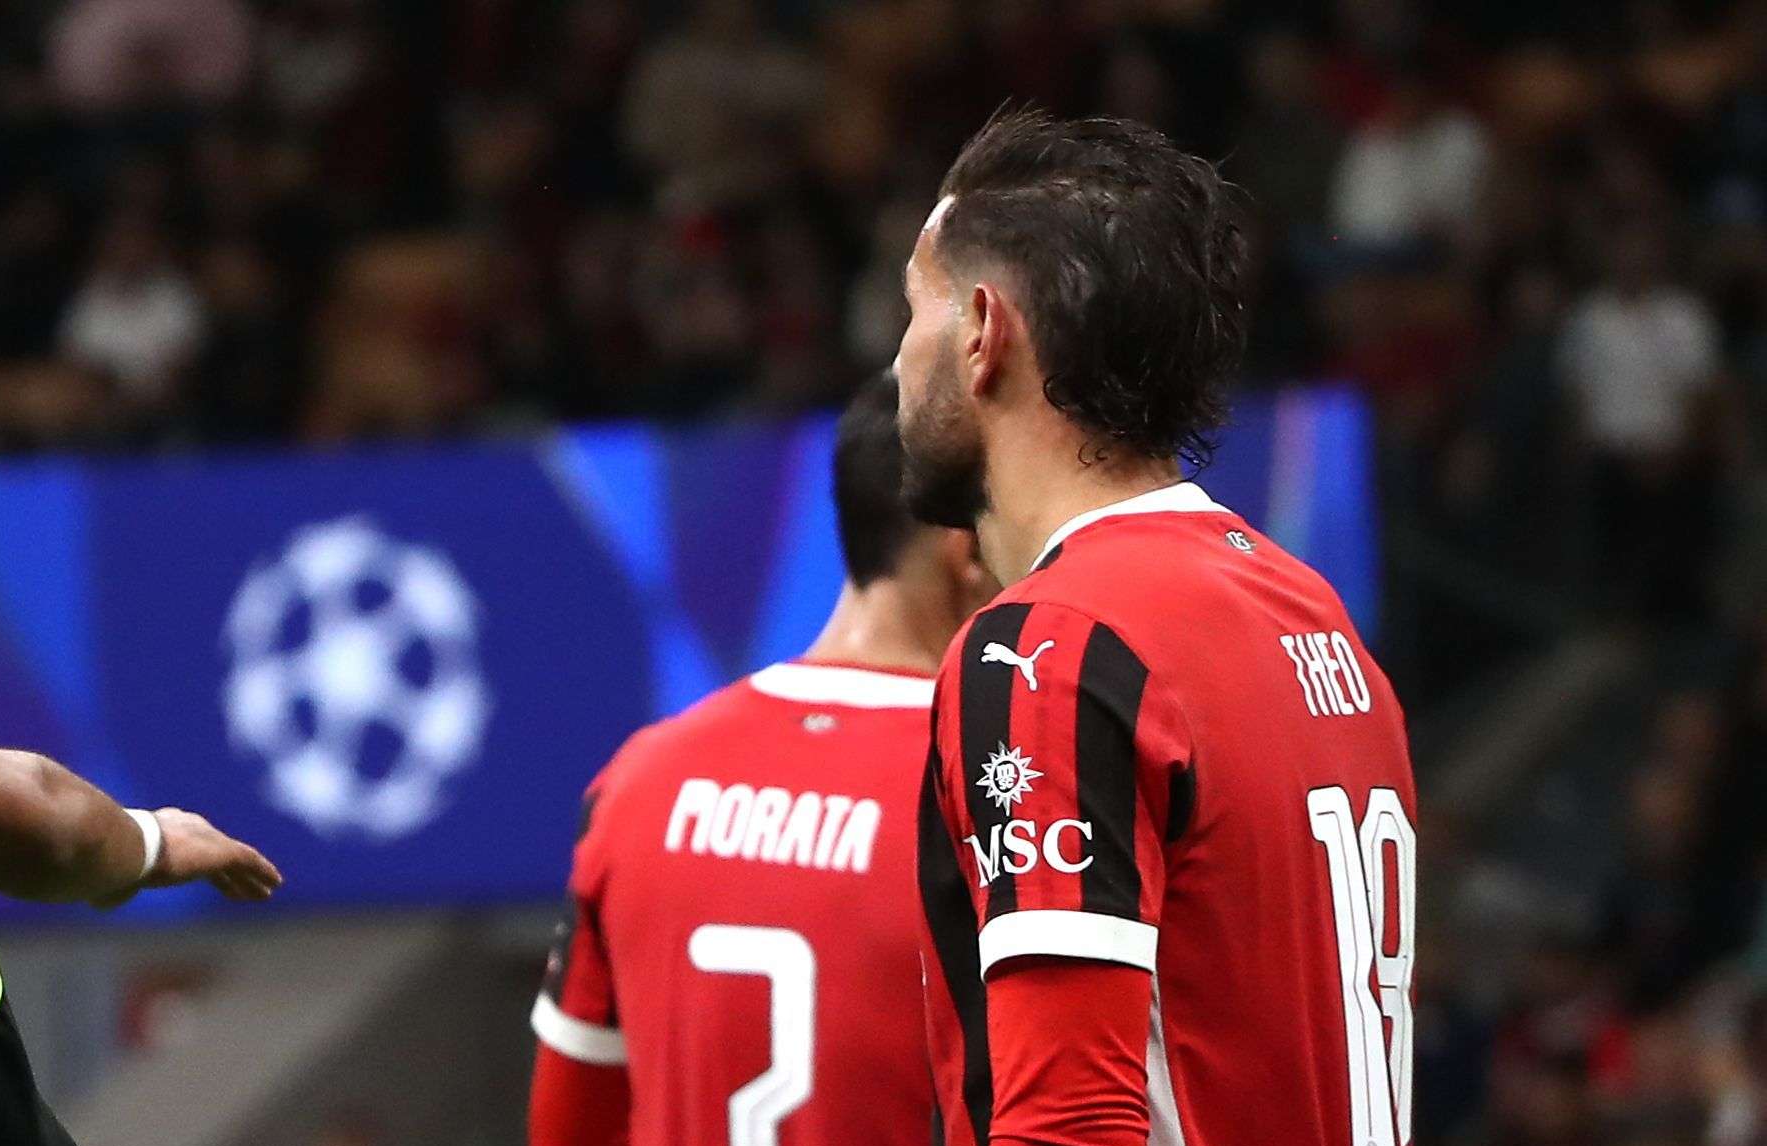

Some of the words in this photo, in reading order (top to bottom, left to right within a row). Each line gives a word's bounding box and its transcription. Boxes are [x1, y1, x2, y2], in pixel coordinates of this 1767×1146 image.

[1280, 631, 1372, 716] THEO
[665, 777, 881, 873] MORATA
[964, 818, 1093, 888] MSC
